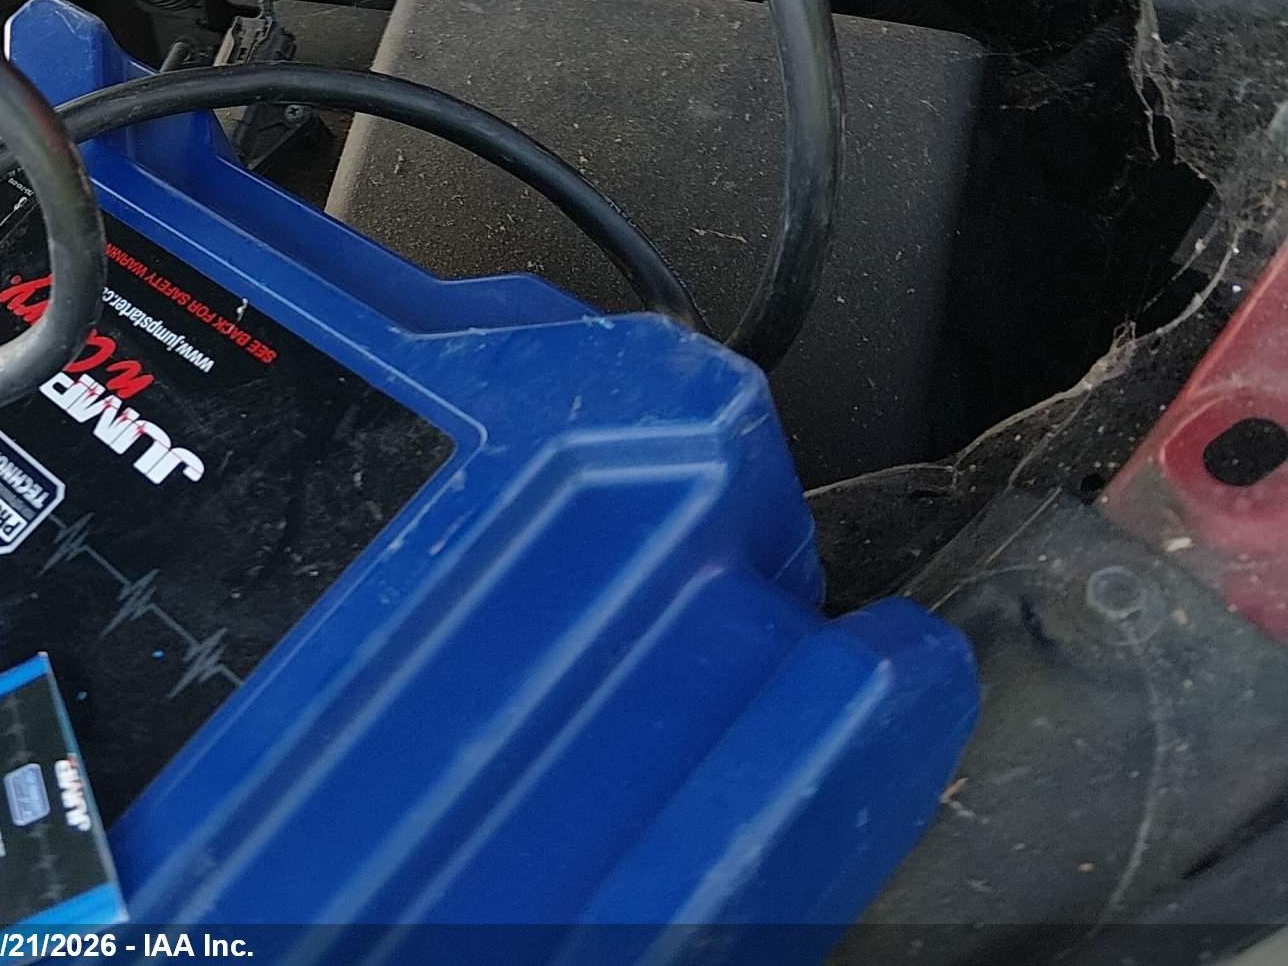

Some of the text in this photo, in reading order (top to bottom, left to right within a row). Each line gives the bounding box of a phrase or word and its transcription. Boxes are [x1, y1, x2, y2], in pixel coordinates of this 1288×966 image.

[101, 287, 215, 373] www.jumpstarter.c
[105, 243, 277, 363] SEE BACK FOR SAFETY WARNIN
[39, 371, 205, 485] JUMP
